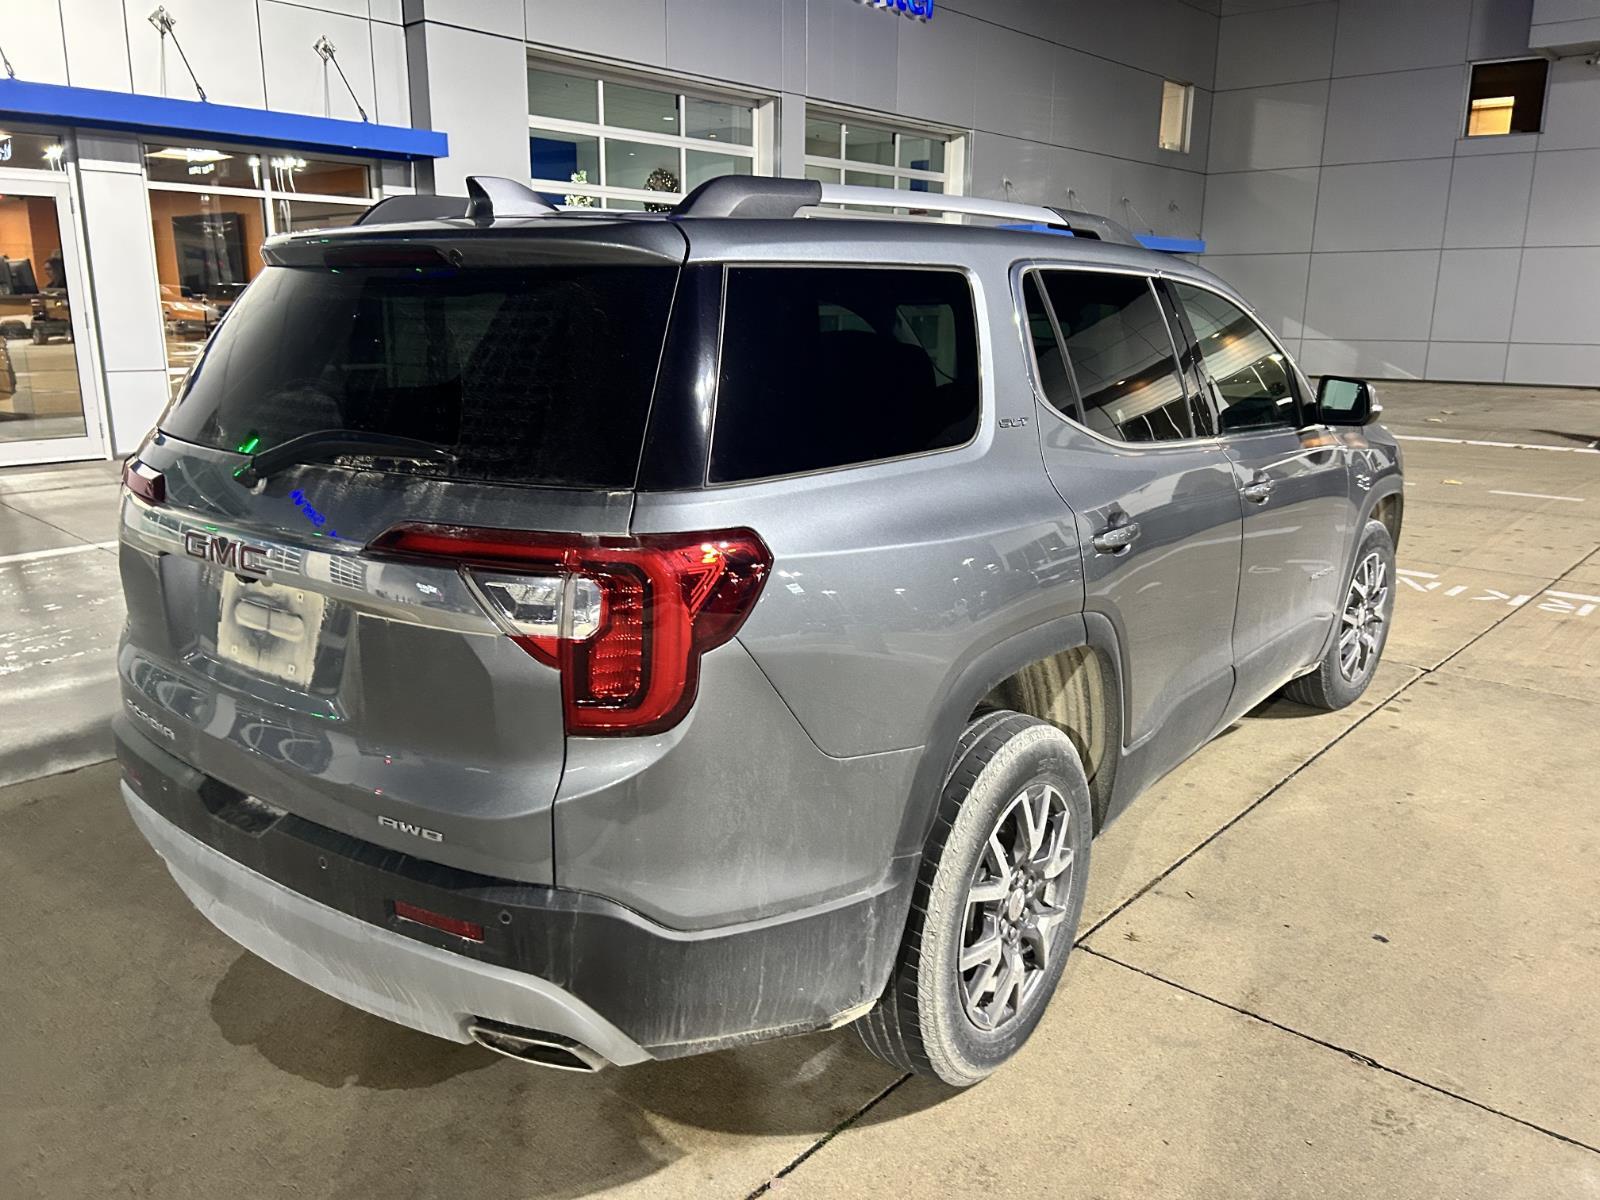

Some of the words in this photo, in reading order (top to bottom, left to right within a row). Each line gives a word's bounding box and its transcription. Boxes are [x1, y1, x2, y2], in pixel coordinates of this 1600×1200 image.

[998, 413, 1029, 429] SLT
[185, 529, 273, 579] GMC
[377, 815, 443, 842] AWD
